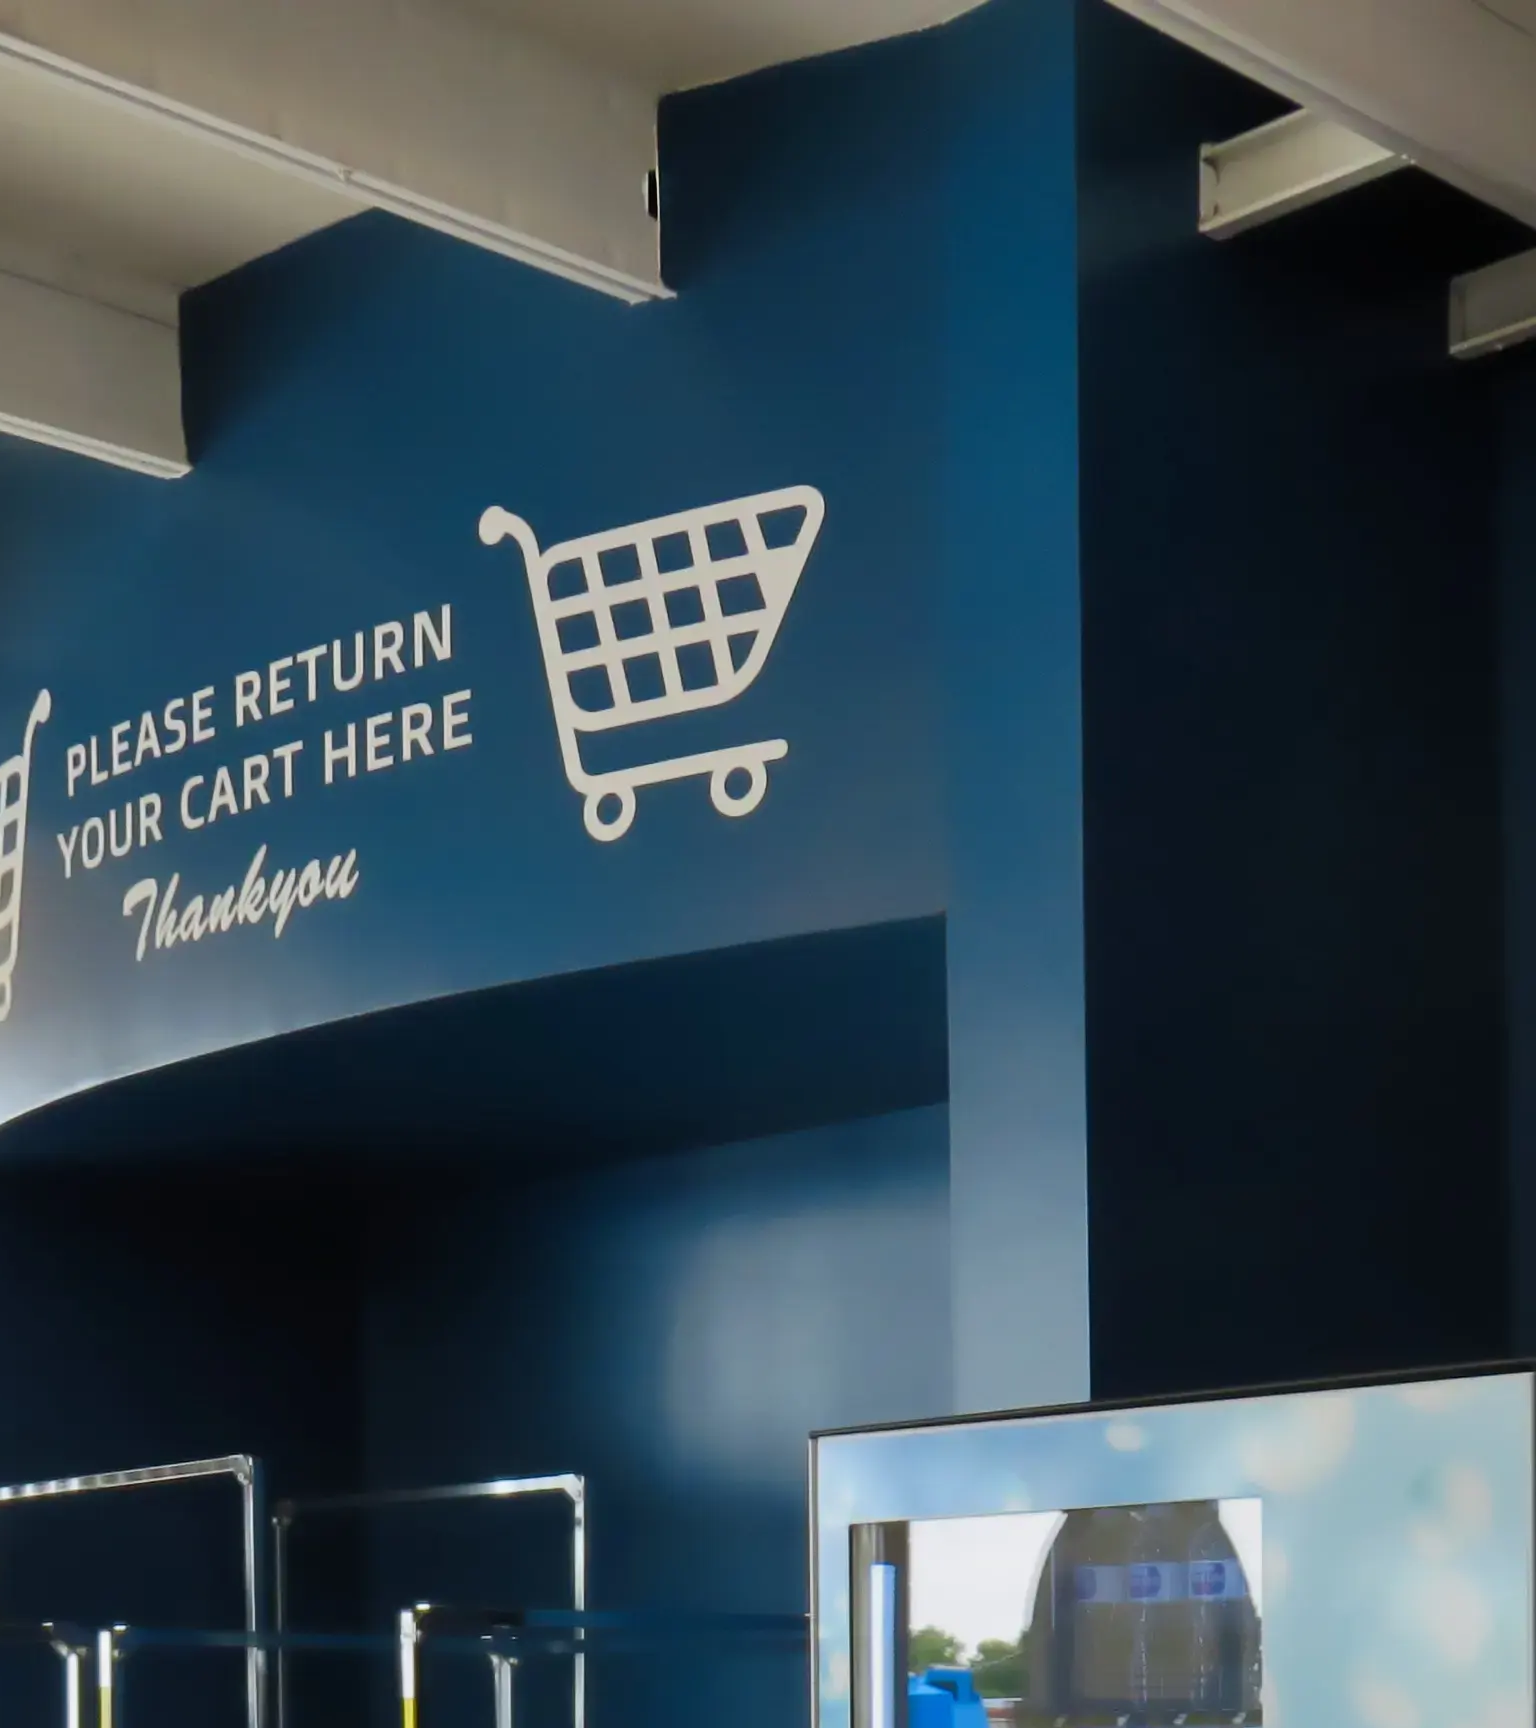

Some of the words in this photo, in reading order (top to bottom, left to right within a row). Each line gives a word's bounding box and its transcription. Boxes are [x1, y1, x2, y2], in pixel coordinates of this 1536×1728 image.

[57, 792, 163, 879] YOUR
[181, 741, 303, 831] CART
[324, 690, 473, 786] HERE
[67, 685, 216, 797] PLEASE
[236, 604, 453, 728] RETURN
[123, 843, 360, 962] Thankyou
